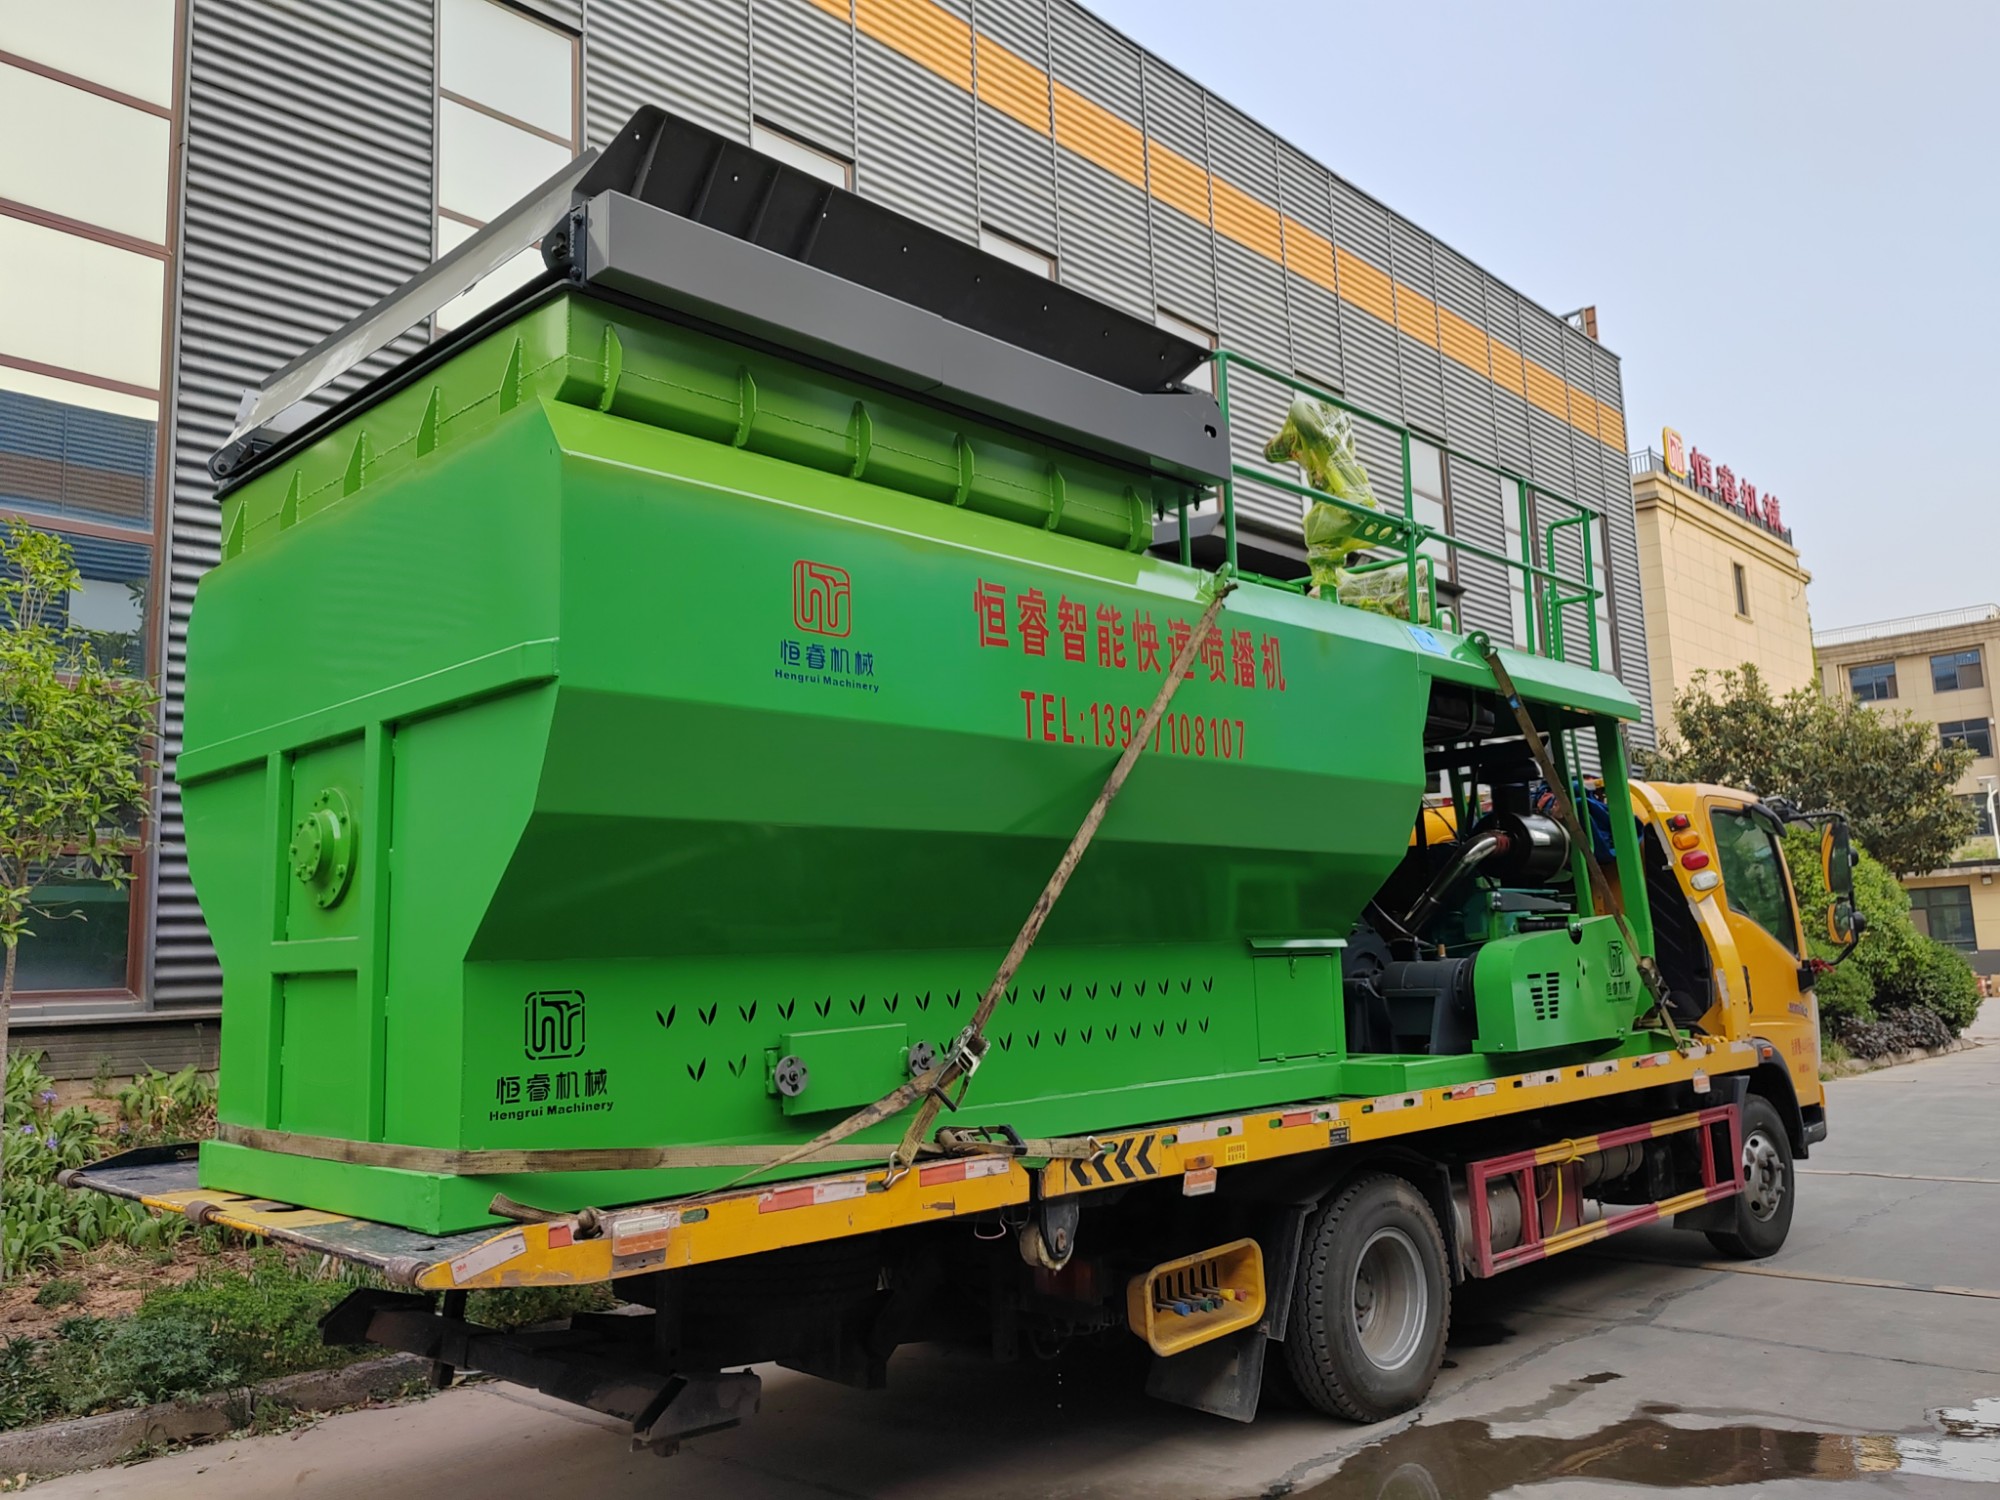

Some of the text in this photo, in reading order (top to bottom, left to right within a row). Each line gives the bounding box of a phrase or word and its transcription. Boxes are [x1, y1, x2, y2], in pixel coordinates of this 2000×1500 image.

[1689, 446, 1788, 532] 恒睿机械
[780, 638, 874, 677] 恒睿机械
[775, 669, 879, 693] Hengrui Machinery
[496, 1068, 608, 1105] 恒睿机械
[489, 1101, 614, 1121] Hengrui Machinery
